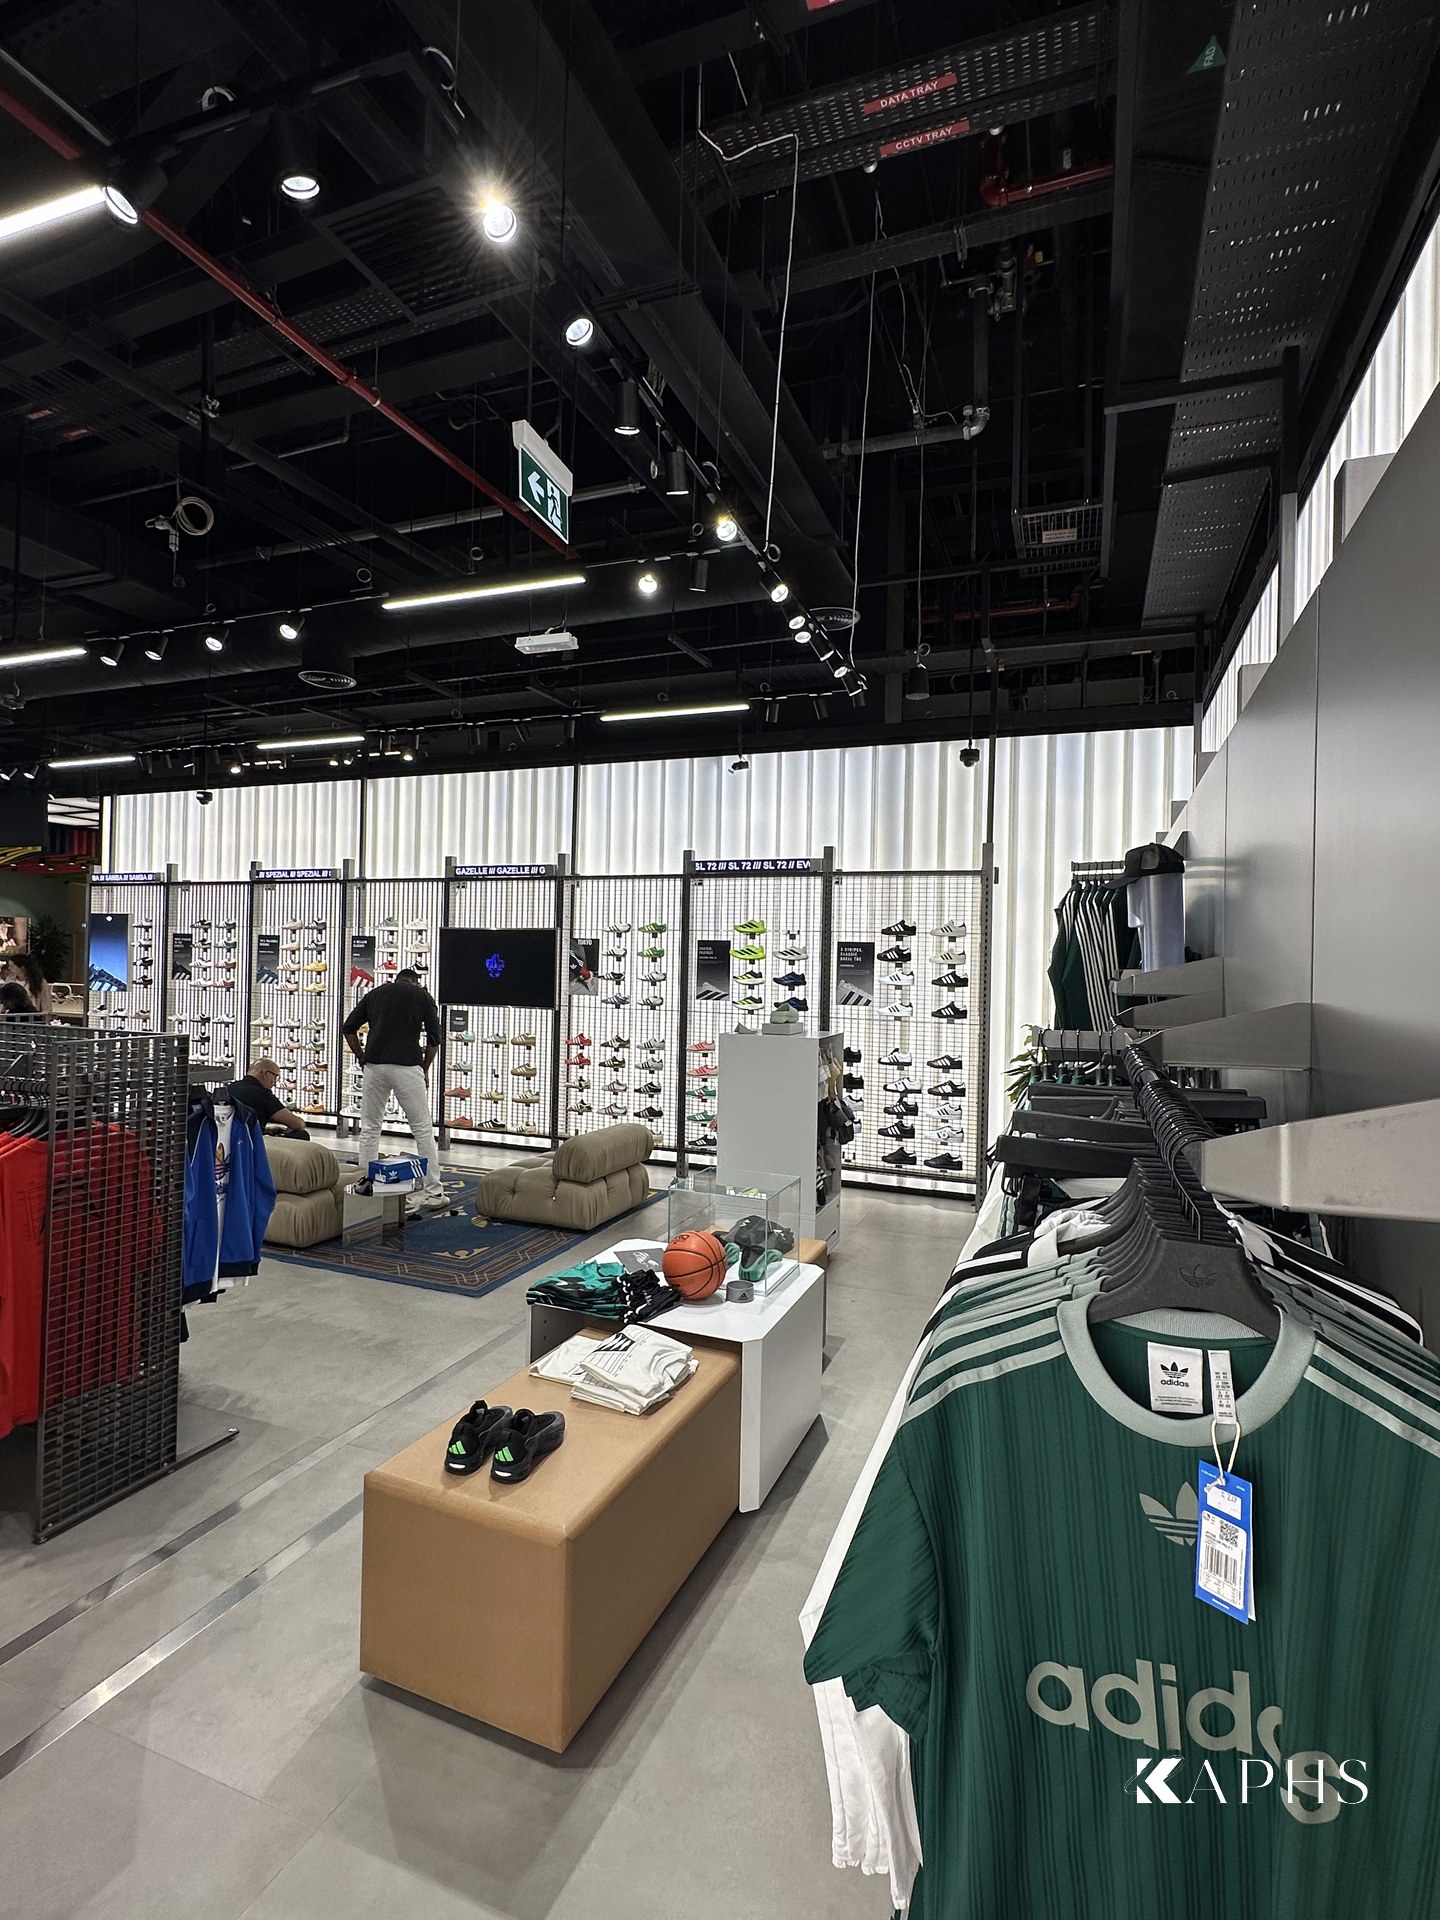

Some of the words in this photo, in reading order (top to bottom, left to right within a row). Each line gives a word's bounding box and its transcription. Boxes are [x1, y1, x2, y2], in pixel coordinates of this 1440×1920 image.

[880, 92, 909, 108] DATA
[910, 81, 939, 98] TRAY
[895, 135, 924, 150] CCTV
[925, 127, 953, 142] TRAY
[455, 867, 488, 875] GAZELLE
[496, 866, 530, 875] GAZELLE
[539, 866, 546, 874] G
[707, 862, 717, 871] 72
[728, 861, 740, 870] SL
[741, 861, 752, 870] 72
[762, 861, 775, 870] SL
[776, 861, 787, 869] 72
[1160, 1379, 1190, 1388] adidas
